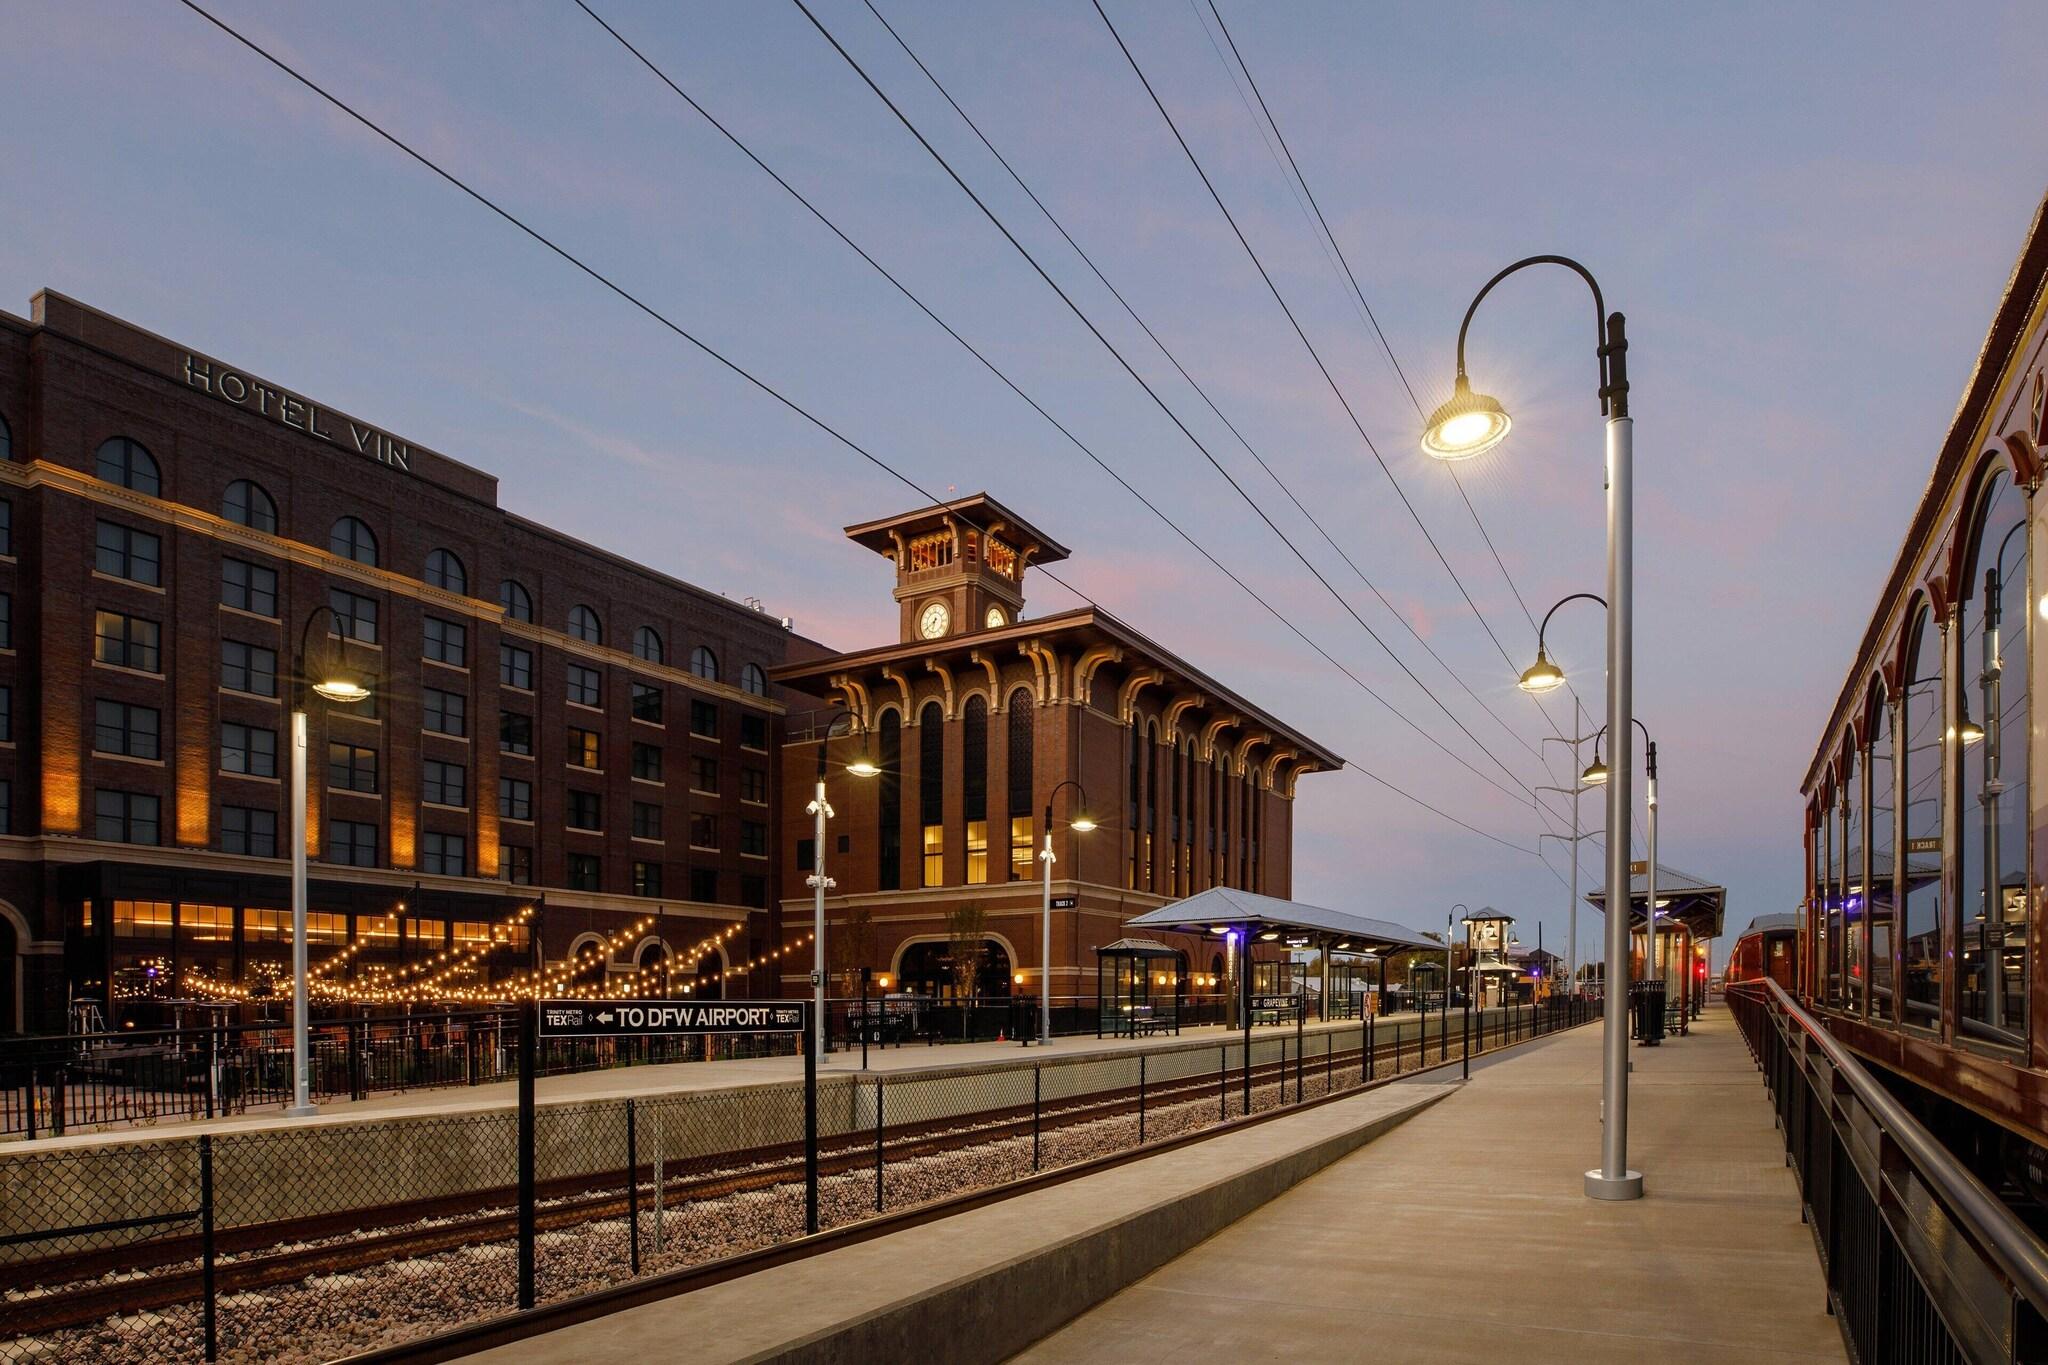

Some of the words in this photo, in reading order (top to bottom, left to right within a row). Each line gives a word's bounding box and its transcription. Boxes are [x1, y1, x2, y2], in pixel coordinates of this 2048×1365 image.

[185, 354, 332, 440] HOTEL
[350, 423, 410, 470] VIN
[1263, 998, 1289, 1008] GRAPEVINE
[616, 1008, 644, 1027] TO
[648, 1008, 694, 1027] DFW
[696, 1008, 769, 1026] AIRPORT
